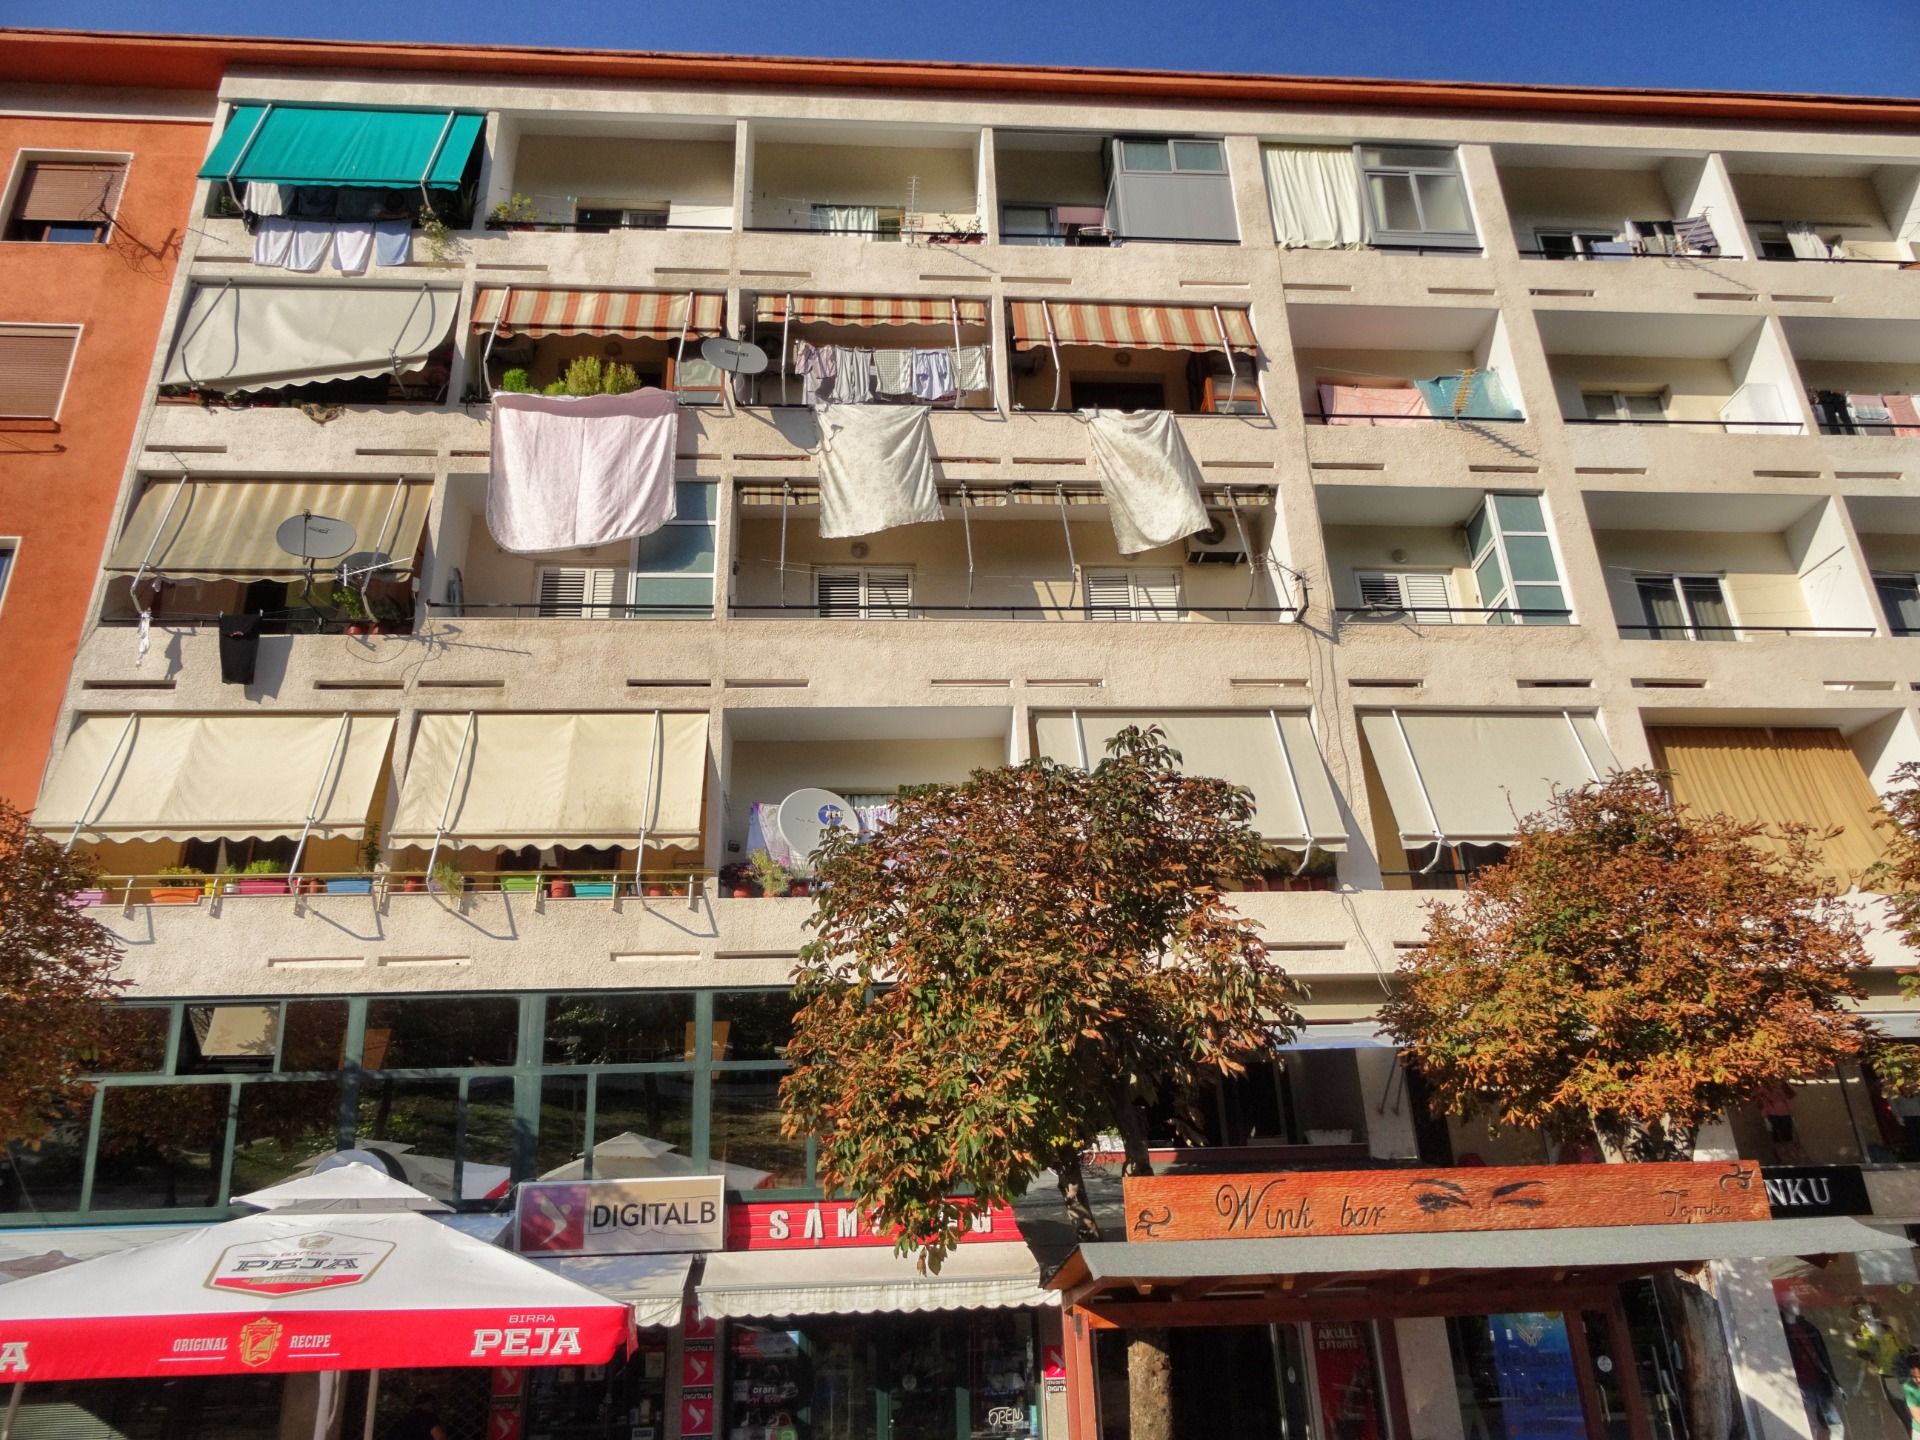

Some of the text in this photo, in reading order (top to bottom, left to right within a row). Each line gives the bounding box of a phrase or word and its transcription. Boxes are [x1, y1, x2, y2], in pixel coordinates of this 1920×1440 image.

[592, 1201, 717, 1228] DIGITALB
[1215, 1178, 1387, 1232] Wink bar
[231, 1257, 359, 1272] PEJA
[508, 1314, 556, 1324] BIRRA
[172, 1334, 332, 1352] ORIGINAL RECIPE
[470, 1327, 582, 1357] PEJA
[988, 1406, 1024, 1426] OPEN
